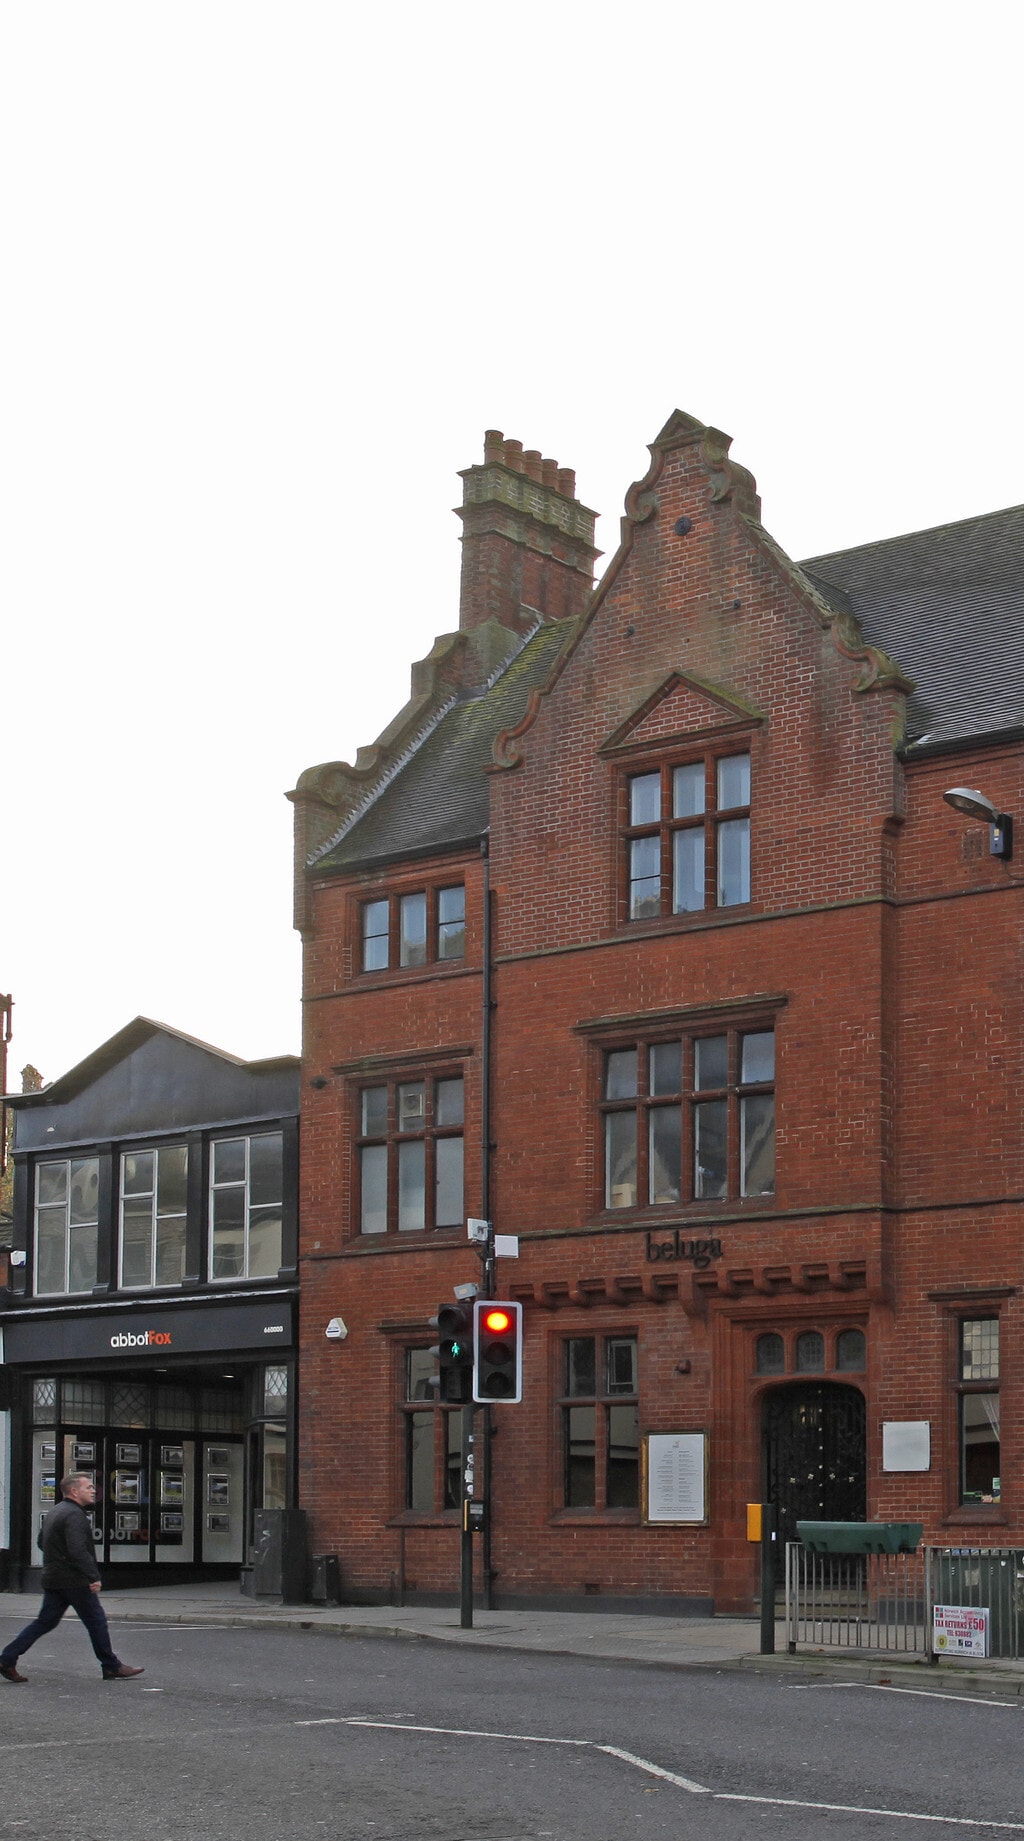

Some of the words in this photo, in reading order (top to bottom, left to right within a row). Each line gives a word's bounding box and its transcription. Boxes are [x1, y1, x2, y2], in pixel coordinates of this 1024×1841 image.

[646, 1230, 724, 1270] beluga
[110, 1330, 172, 1348] abbotFox
[945, 1620, 967, 1629] RETURNS
